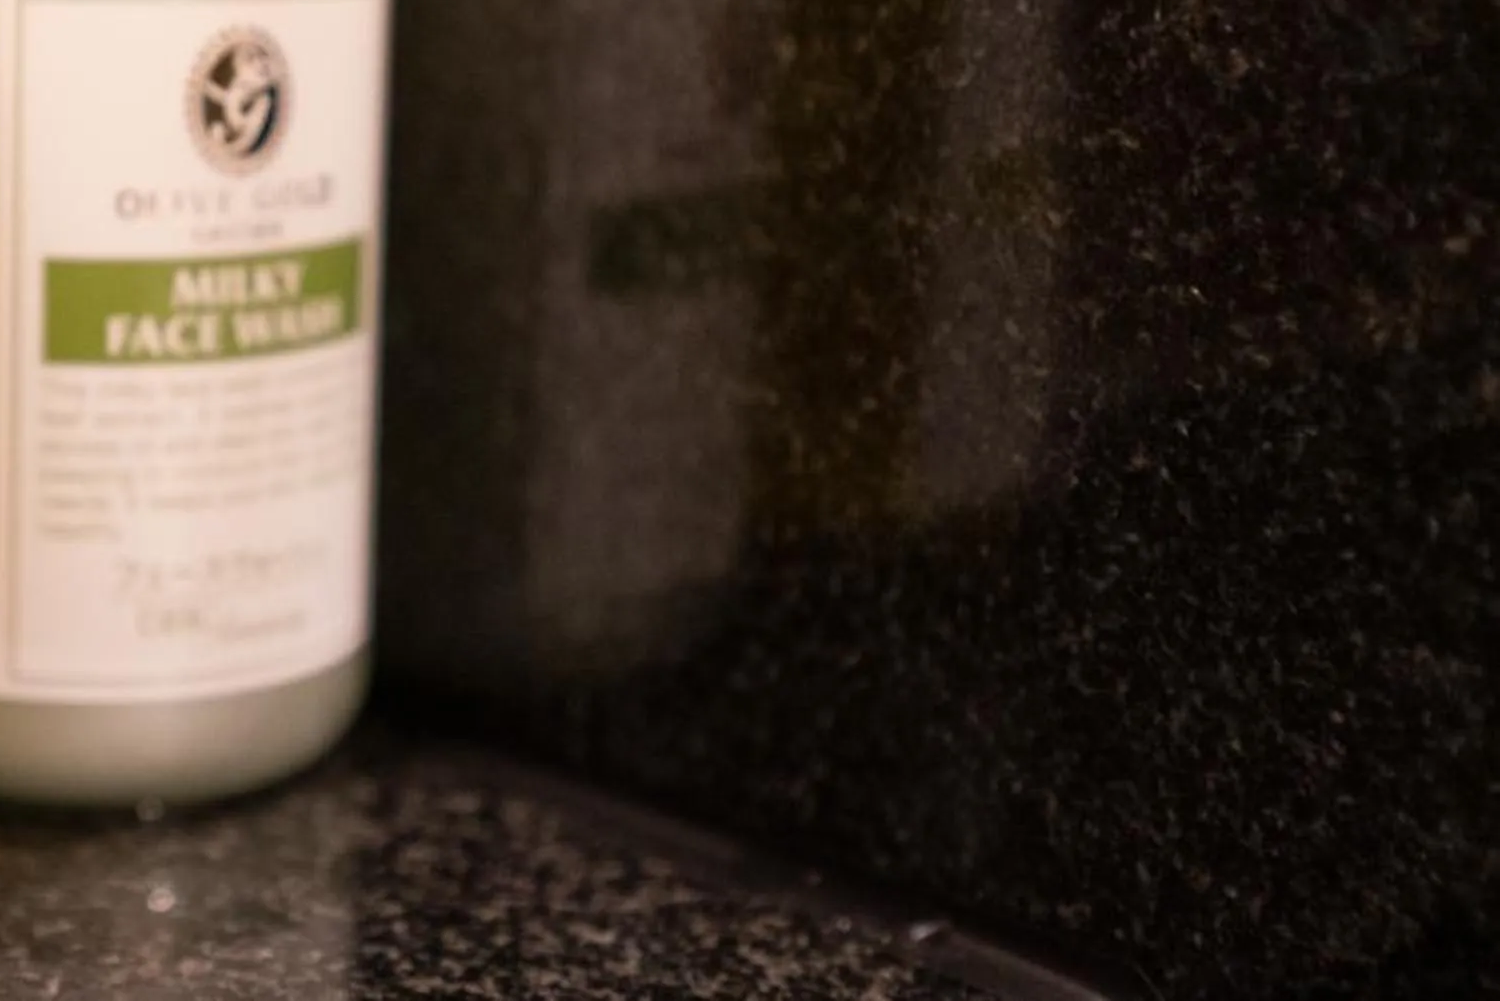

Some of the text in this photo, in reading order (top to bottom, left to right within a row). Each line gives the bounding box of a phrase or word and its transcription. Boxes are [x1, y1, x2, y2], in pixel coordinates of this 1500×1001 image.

[169, 259, 307, 308] MILKY
[104, 297, 345, 359] FACE WASH
